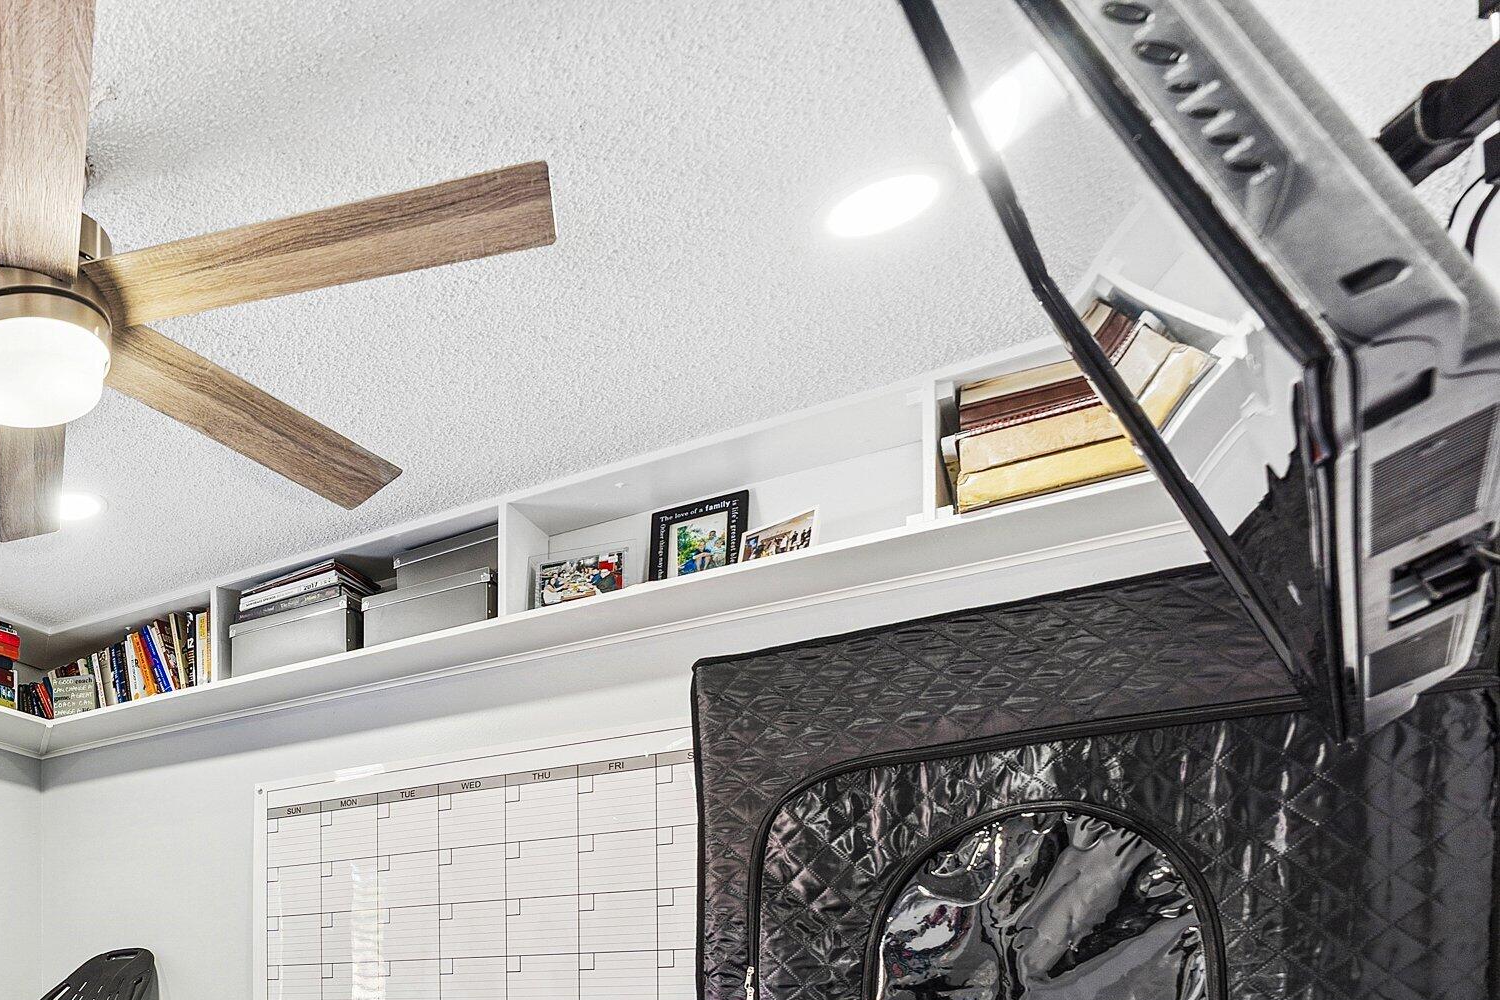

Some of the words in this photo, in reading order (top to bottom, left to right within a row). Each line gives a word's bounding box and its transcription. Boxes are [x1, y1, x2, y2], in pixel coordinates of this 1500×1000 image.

[705, 500, 730, 512] family
[304, 582, 318, 591] 2017
[608, 762, 624, 770] FRI
[532, 771, 551, 780] THU
[461, 780, 482, 790] WED
[400, 790, 416, 798] TUE
[340, 799, 358, 808] MON
[286, 806, 302, 814] SUN
